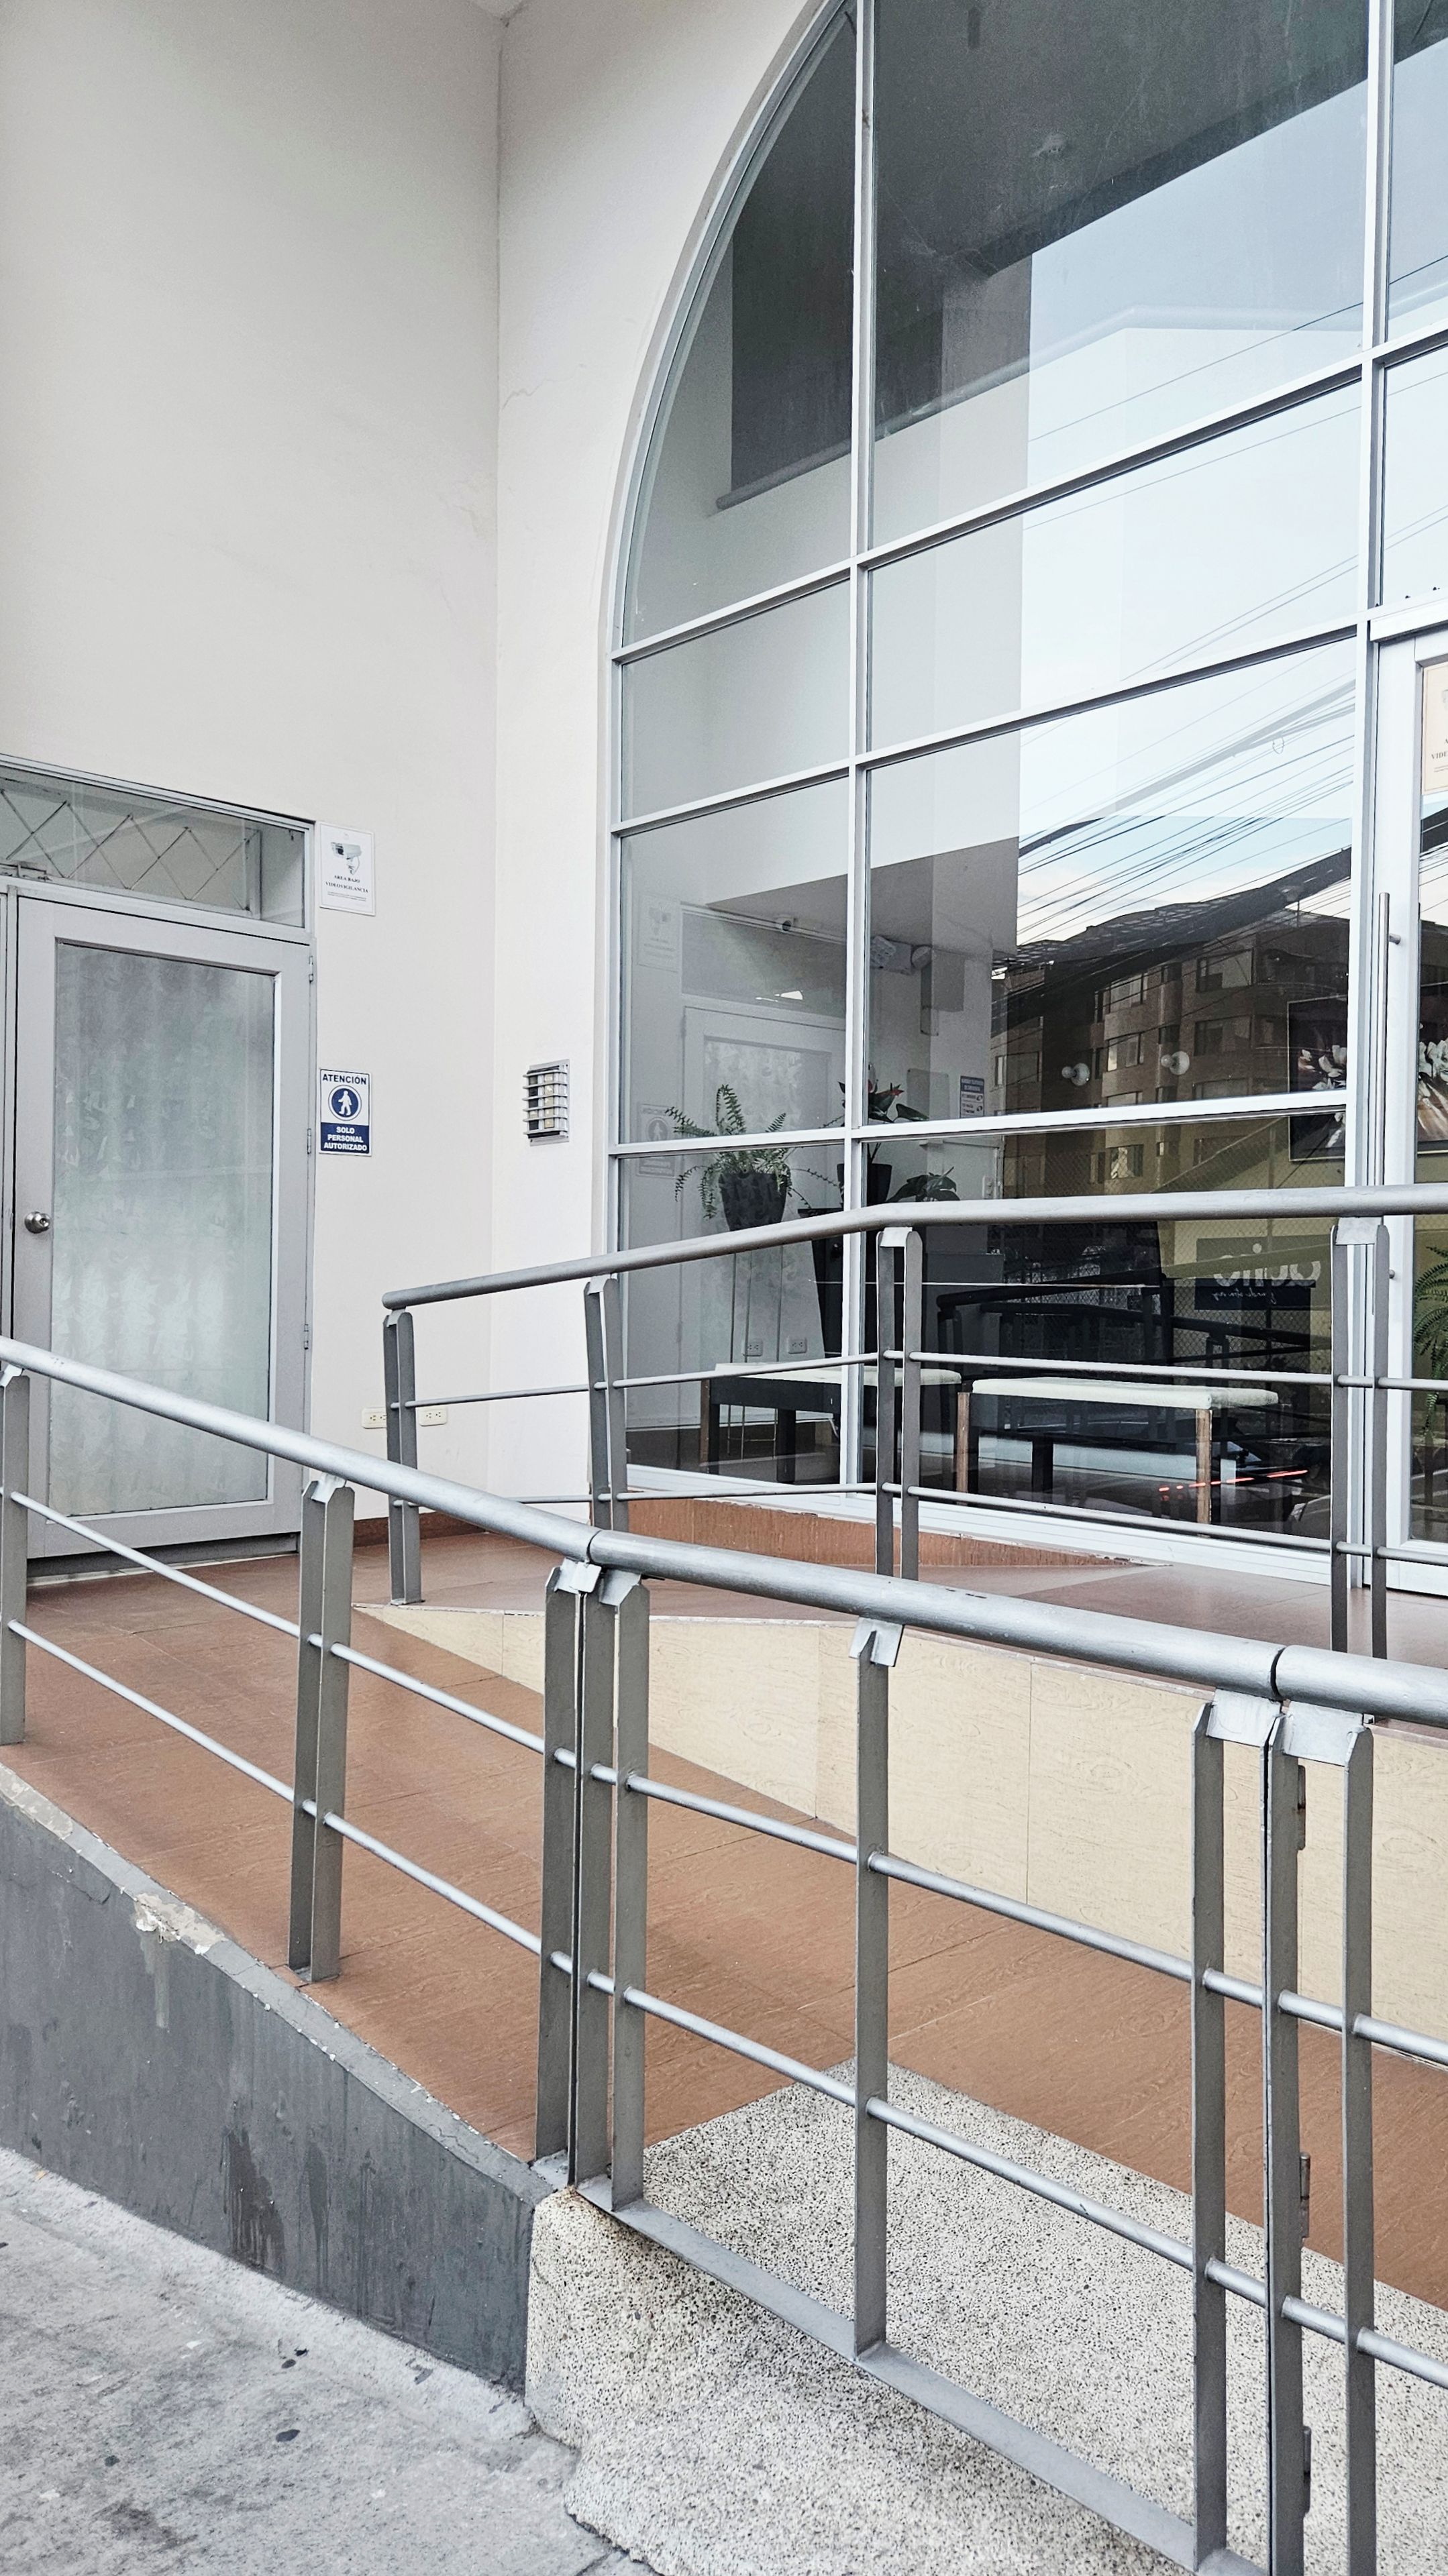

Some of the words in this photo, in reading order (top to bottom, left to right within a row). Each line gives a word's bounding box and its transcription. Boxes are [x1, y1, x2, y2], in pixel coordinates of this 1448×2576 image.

[335, 1126, 355, 1134] SOLO
[327, 1134, 364, 1143] PERSONAL
[323, 1142, 368, 1151] AUTORIZADO
